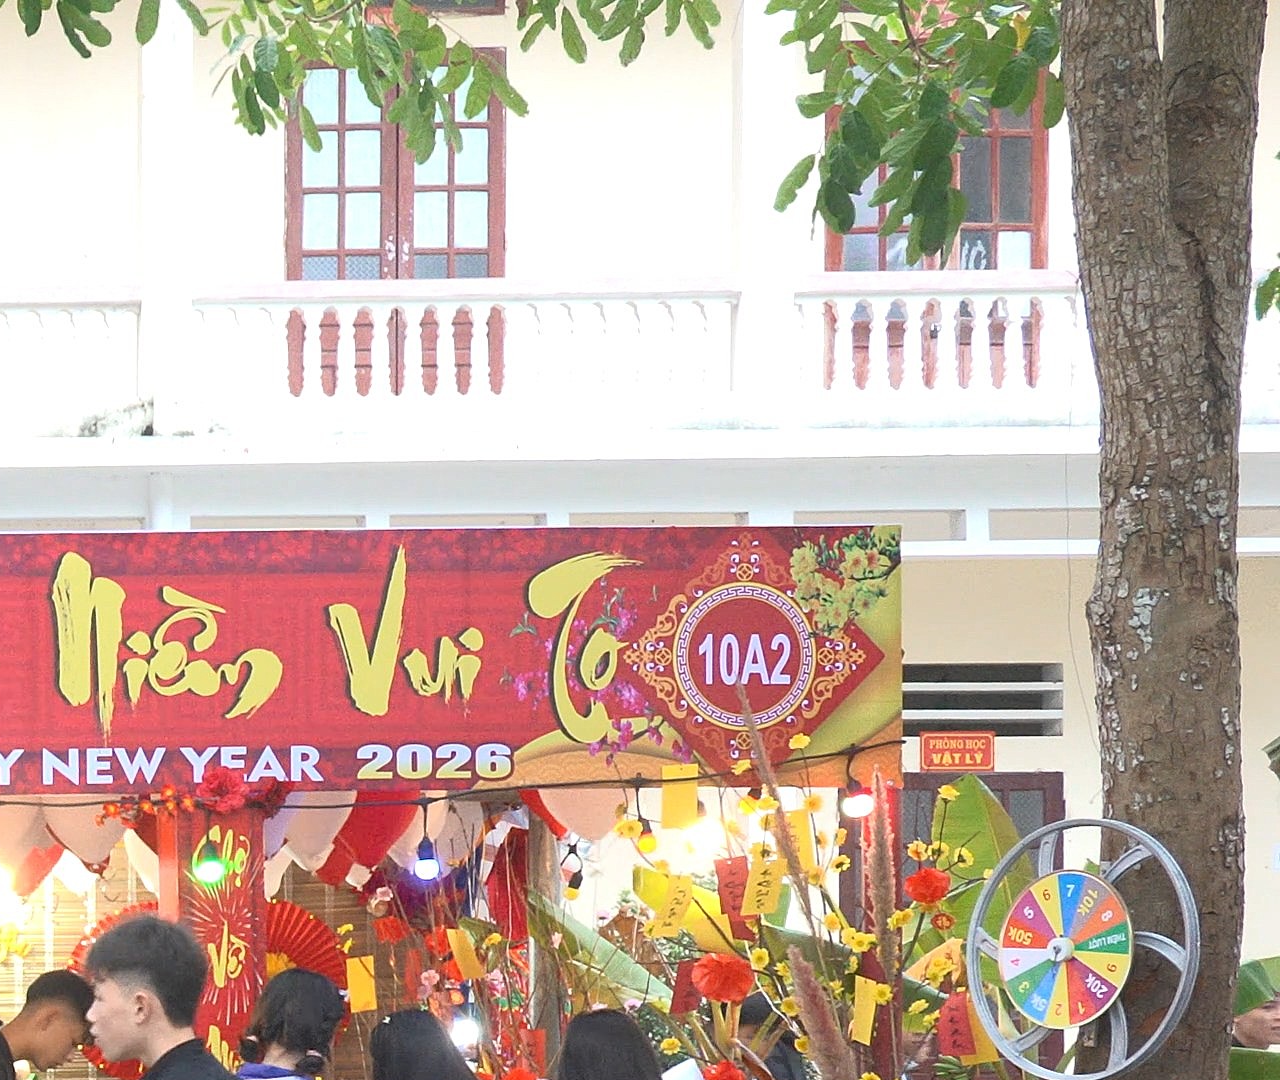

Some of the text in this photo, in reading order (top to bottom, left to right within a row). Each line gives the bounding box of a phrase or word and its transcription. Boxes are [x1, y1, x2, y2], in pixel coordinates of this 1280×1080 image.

[51, 551, 283, 744] Niềm
[329, 543, 486, 718] Vui
[698, 633, 792, 686] 10A2
[929, 737, 986, 751] PHÒNG HỌC
[42, 746, 166, 785] NEW
[179, 744, 323, 783] YEAR
[356, 742, 513, 781] 2026
[932, 751, 983, 766] VẬT LÝ
[1066, 884, 1075, 898] 7
[1101, 910, 1113, 922] 8
[207, 920, 251, 988] Về
[1018, 981, 1030, 993] 3
[1055, 1003, 1063, 1016] 2
[1077, 1001, 1086, 1015] 1
